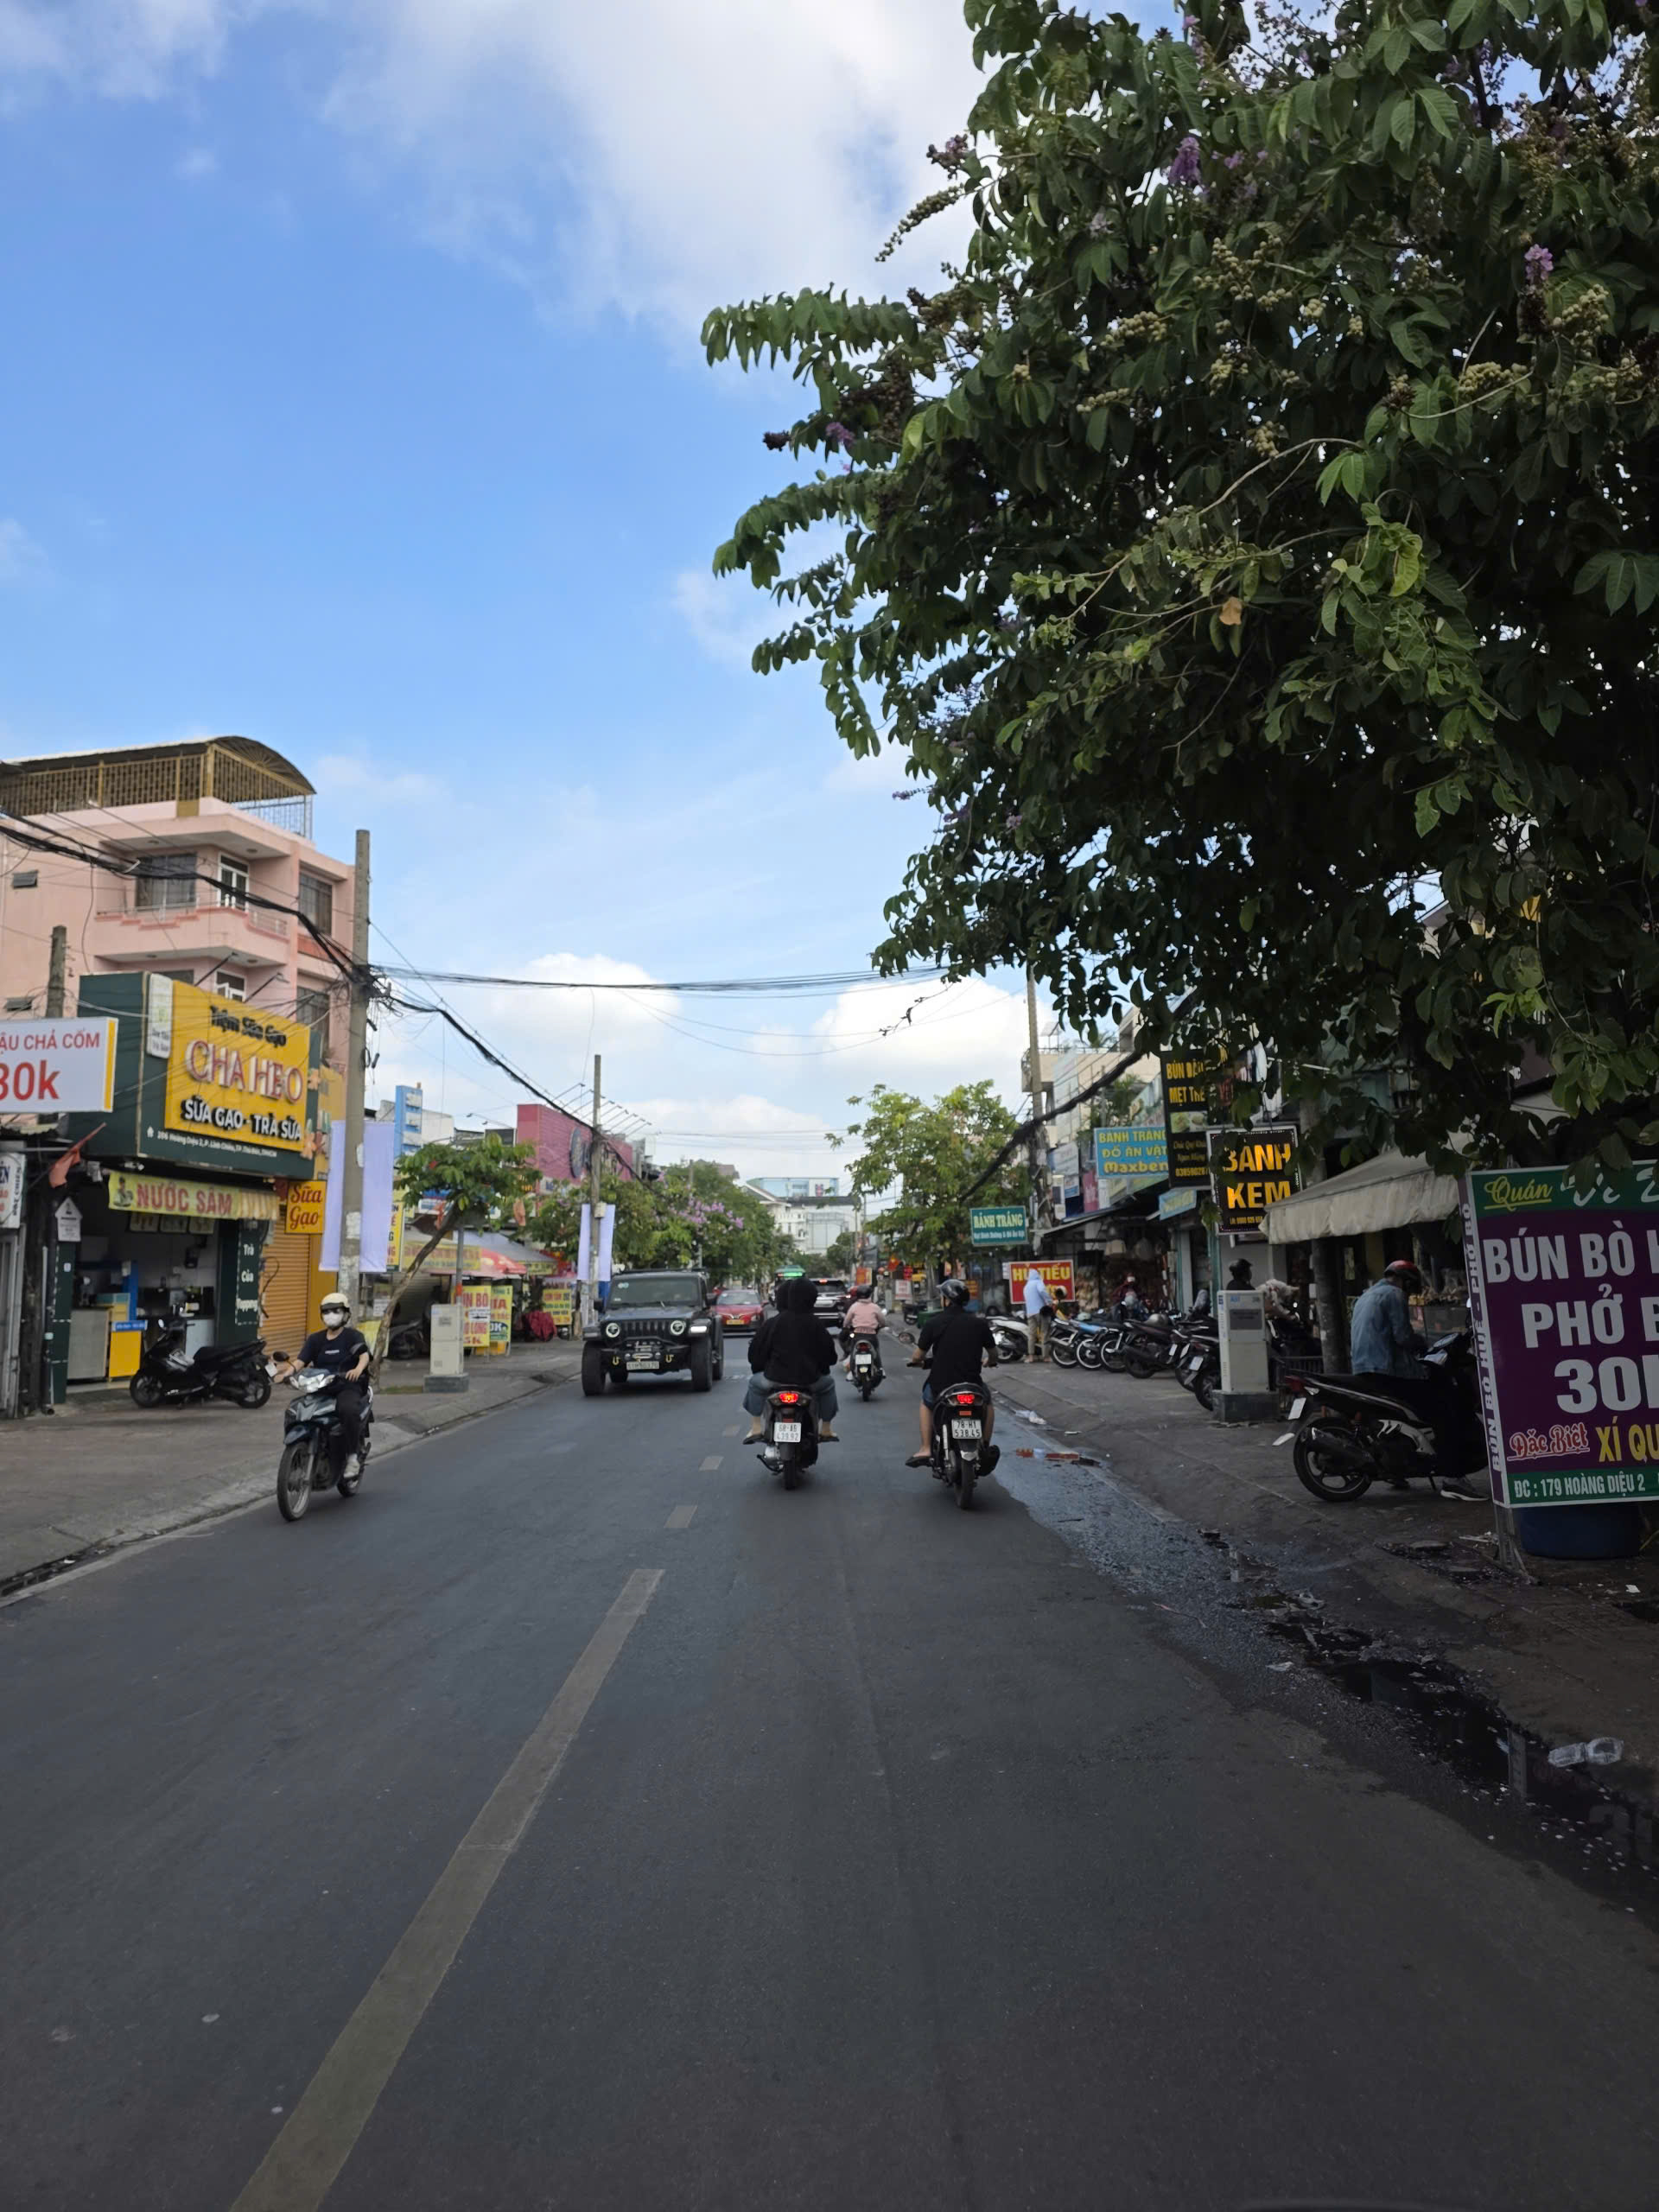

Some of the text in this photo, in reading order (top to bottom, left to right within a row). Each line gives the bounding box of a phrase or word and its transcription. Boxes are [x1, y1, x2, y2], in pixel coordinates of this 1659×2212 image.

[23, 1029, 57, 1050] CHẢ
[63, 1027, 99, 1049] CỐM
[249, 1057, 302, 1104] HEO
[215, 1107, 243, 1130] GẠO
[136, 1182, 232, 1216] NƯỚC SÂM
[290, 1184, 322, 1205] Sữa
[1484, 1176, 1554, 1211] Quán
[289, 1205, 320, 1230] Gạo
[1483, 1227, 1569, 1283] BÚN
[1580, 1220, 1636, 1277] BÒ
[1522, 1283, 1625, 1348] PHỞ
[1481, 1376, 1493, 1410] BÒ
[1486, 1417, 1502, 1472] BÚN
[1510, 1428, 1548, 1459] Đặc
[1549, 1422, 1589, 1455] Biệt
[1596, 1415, 1622, 1462] XÍ
[1515, 1480, 1531, 1498] ĐC
[1541, 1478, 1562, 1497] 179
[1565, 1473, 1605, 1496] HOÀNG
[1606, 1471, 1635, 1497] DIỆU
[1637, 1473, 1646, 1491] 2
